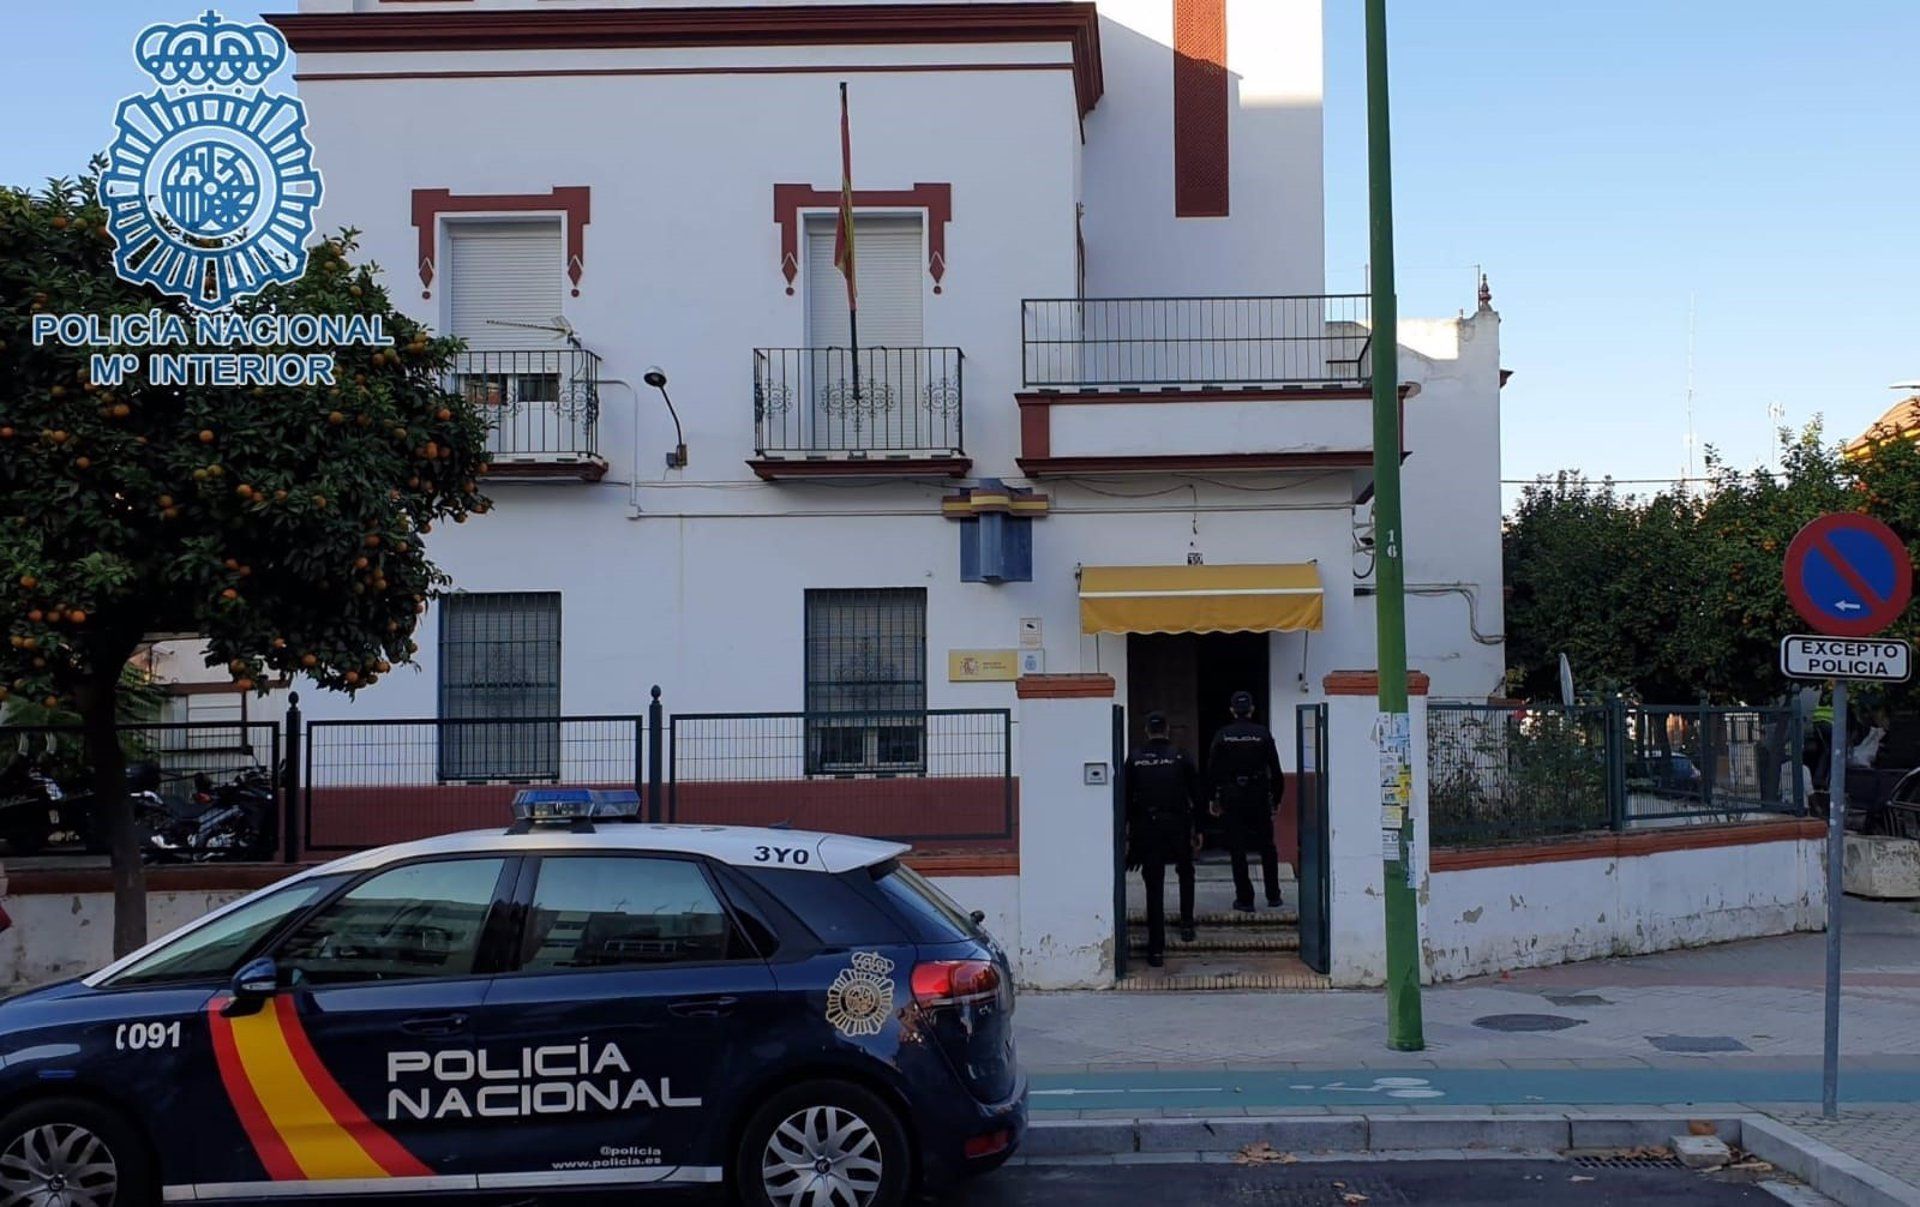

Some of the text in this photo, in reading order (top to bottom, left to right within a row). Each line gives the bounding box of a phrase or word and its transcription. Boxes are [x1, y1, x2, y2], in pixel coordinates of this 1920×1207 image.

[1801, 641, 1898, 659] EXCEPTO
[1808, 658, 1888, 675] POLICIA
[387, 1036, 631, 1083] POLICÍA
[387, 1077, 702, 1120] NACIONAL
[600, 1145, 662, 1157] @policia
[551, 1156, 662, 1171] www.policia.es
